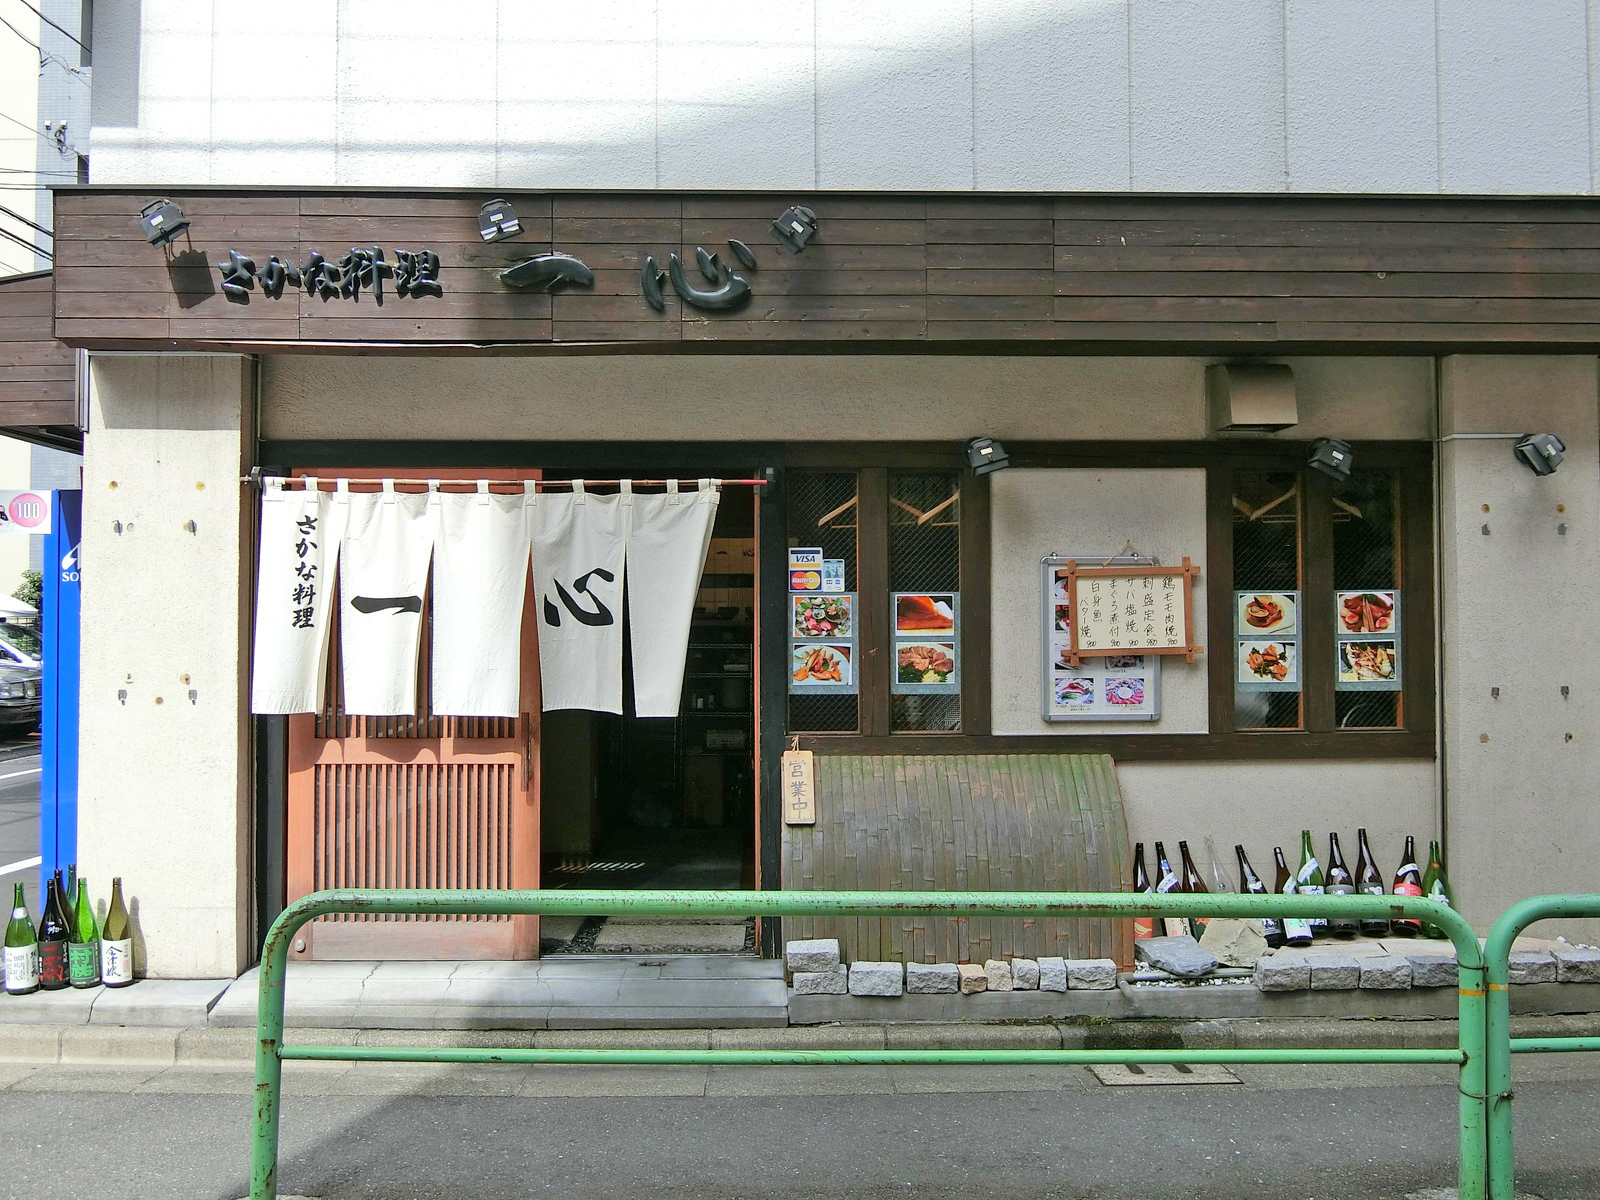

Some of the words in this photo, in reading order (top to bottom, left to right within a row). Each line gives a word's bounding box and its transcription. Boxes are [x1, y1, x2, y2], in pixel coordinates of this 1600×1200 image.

[218, 247, 443, 306] さかな料理
[16, 502, 41, 519] 100
[61, 571, 81, 582] SO
[292, 514, 319, 629] さかな料理
[796, 555, 816, 563] VISA
[1091, 580, 1102, 622] 白身魚
[1142, 577, 1156, 637] 刺盛定食
[1162, 576, 1178, 637] 鶏モモ肉焼
[788, 760, 808, 819] 営業中
